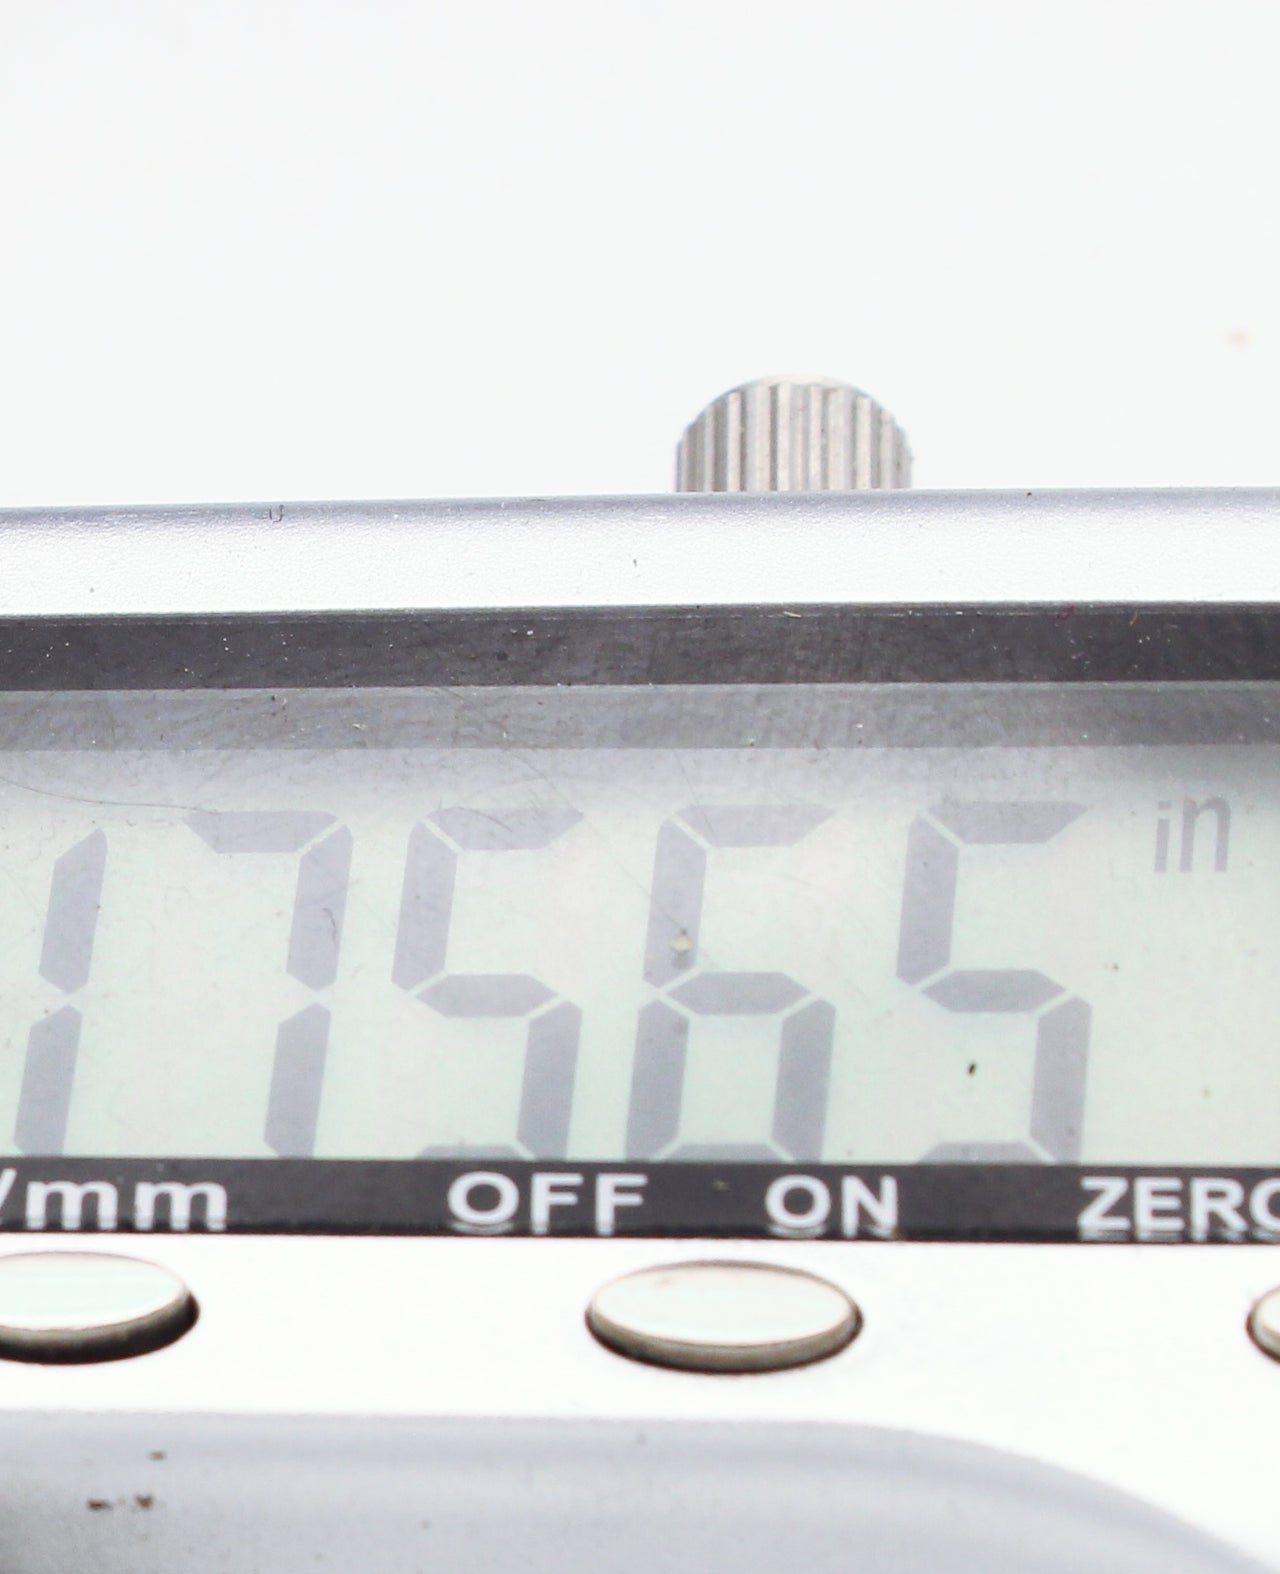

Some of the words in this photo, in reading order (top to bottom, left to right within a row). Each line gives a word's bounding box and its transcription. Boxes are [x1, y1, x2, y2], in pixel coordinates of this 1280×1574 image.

[1153, 797, 1232, 873] in
[447, 1170, 648, 1235] OFF
[765, 1174, 899, 1238] ON
